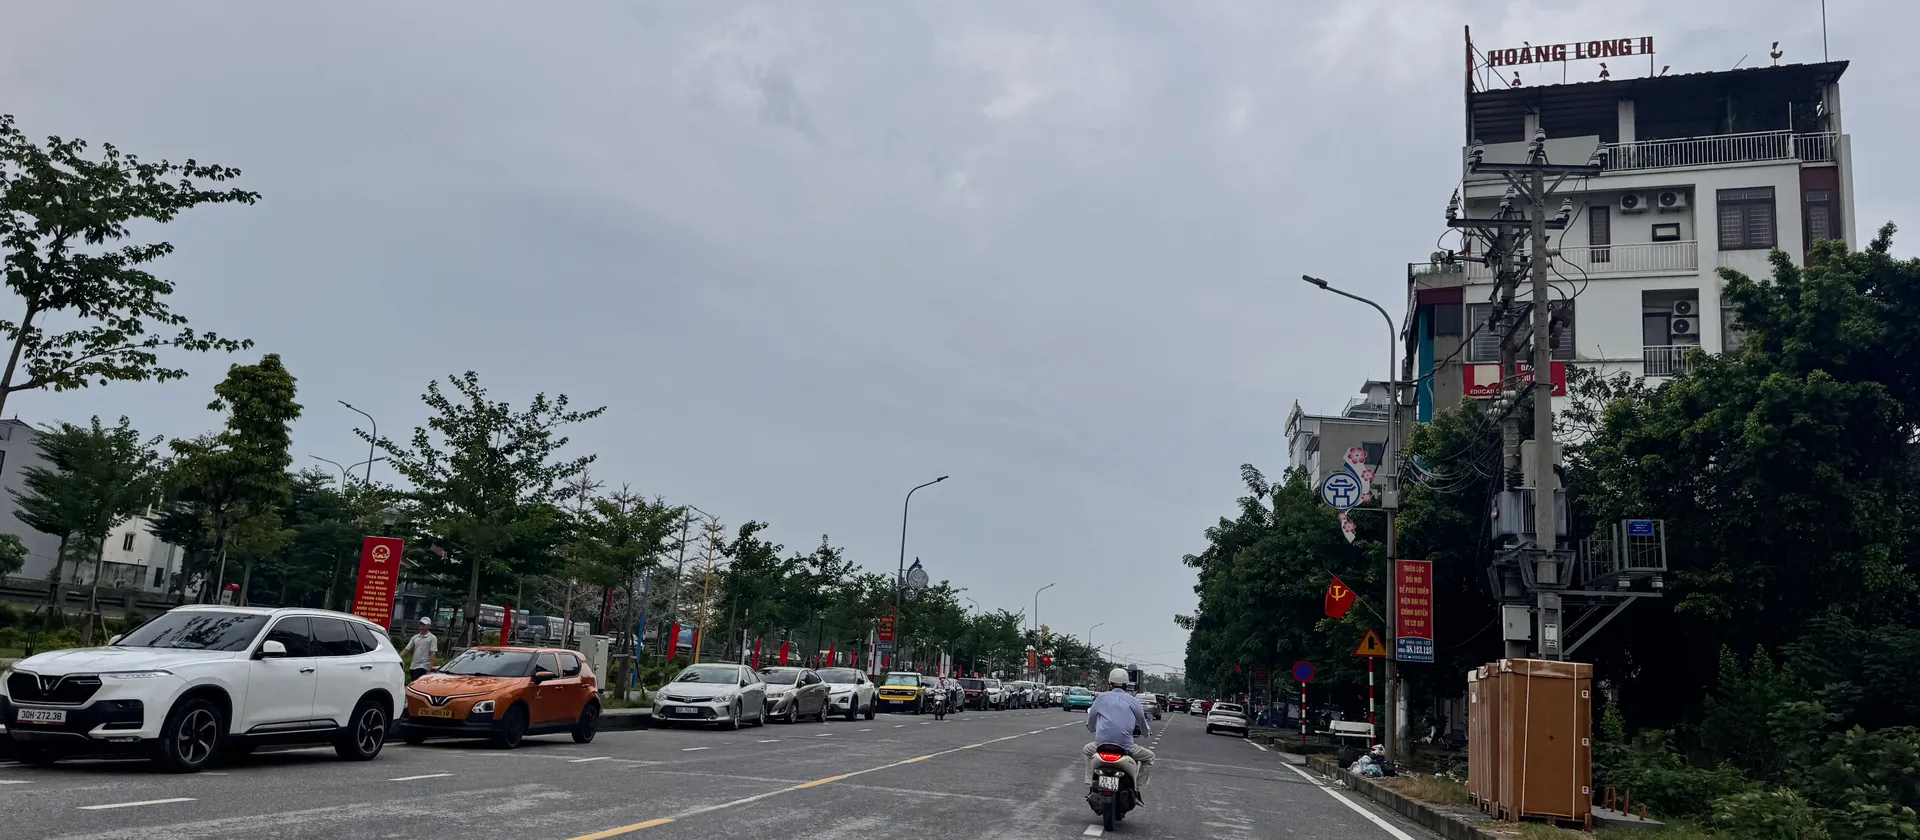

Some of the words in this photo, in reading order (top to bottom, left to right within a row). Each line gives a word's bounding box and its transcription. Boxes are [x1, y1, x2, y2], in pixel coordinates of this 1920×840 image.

[1576, 38, 1632, 60] LONG
[1640, 36, 1653, 54] II
[21, 711, 62, 720] 30H-272.38
